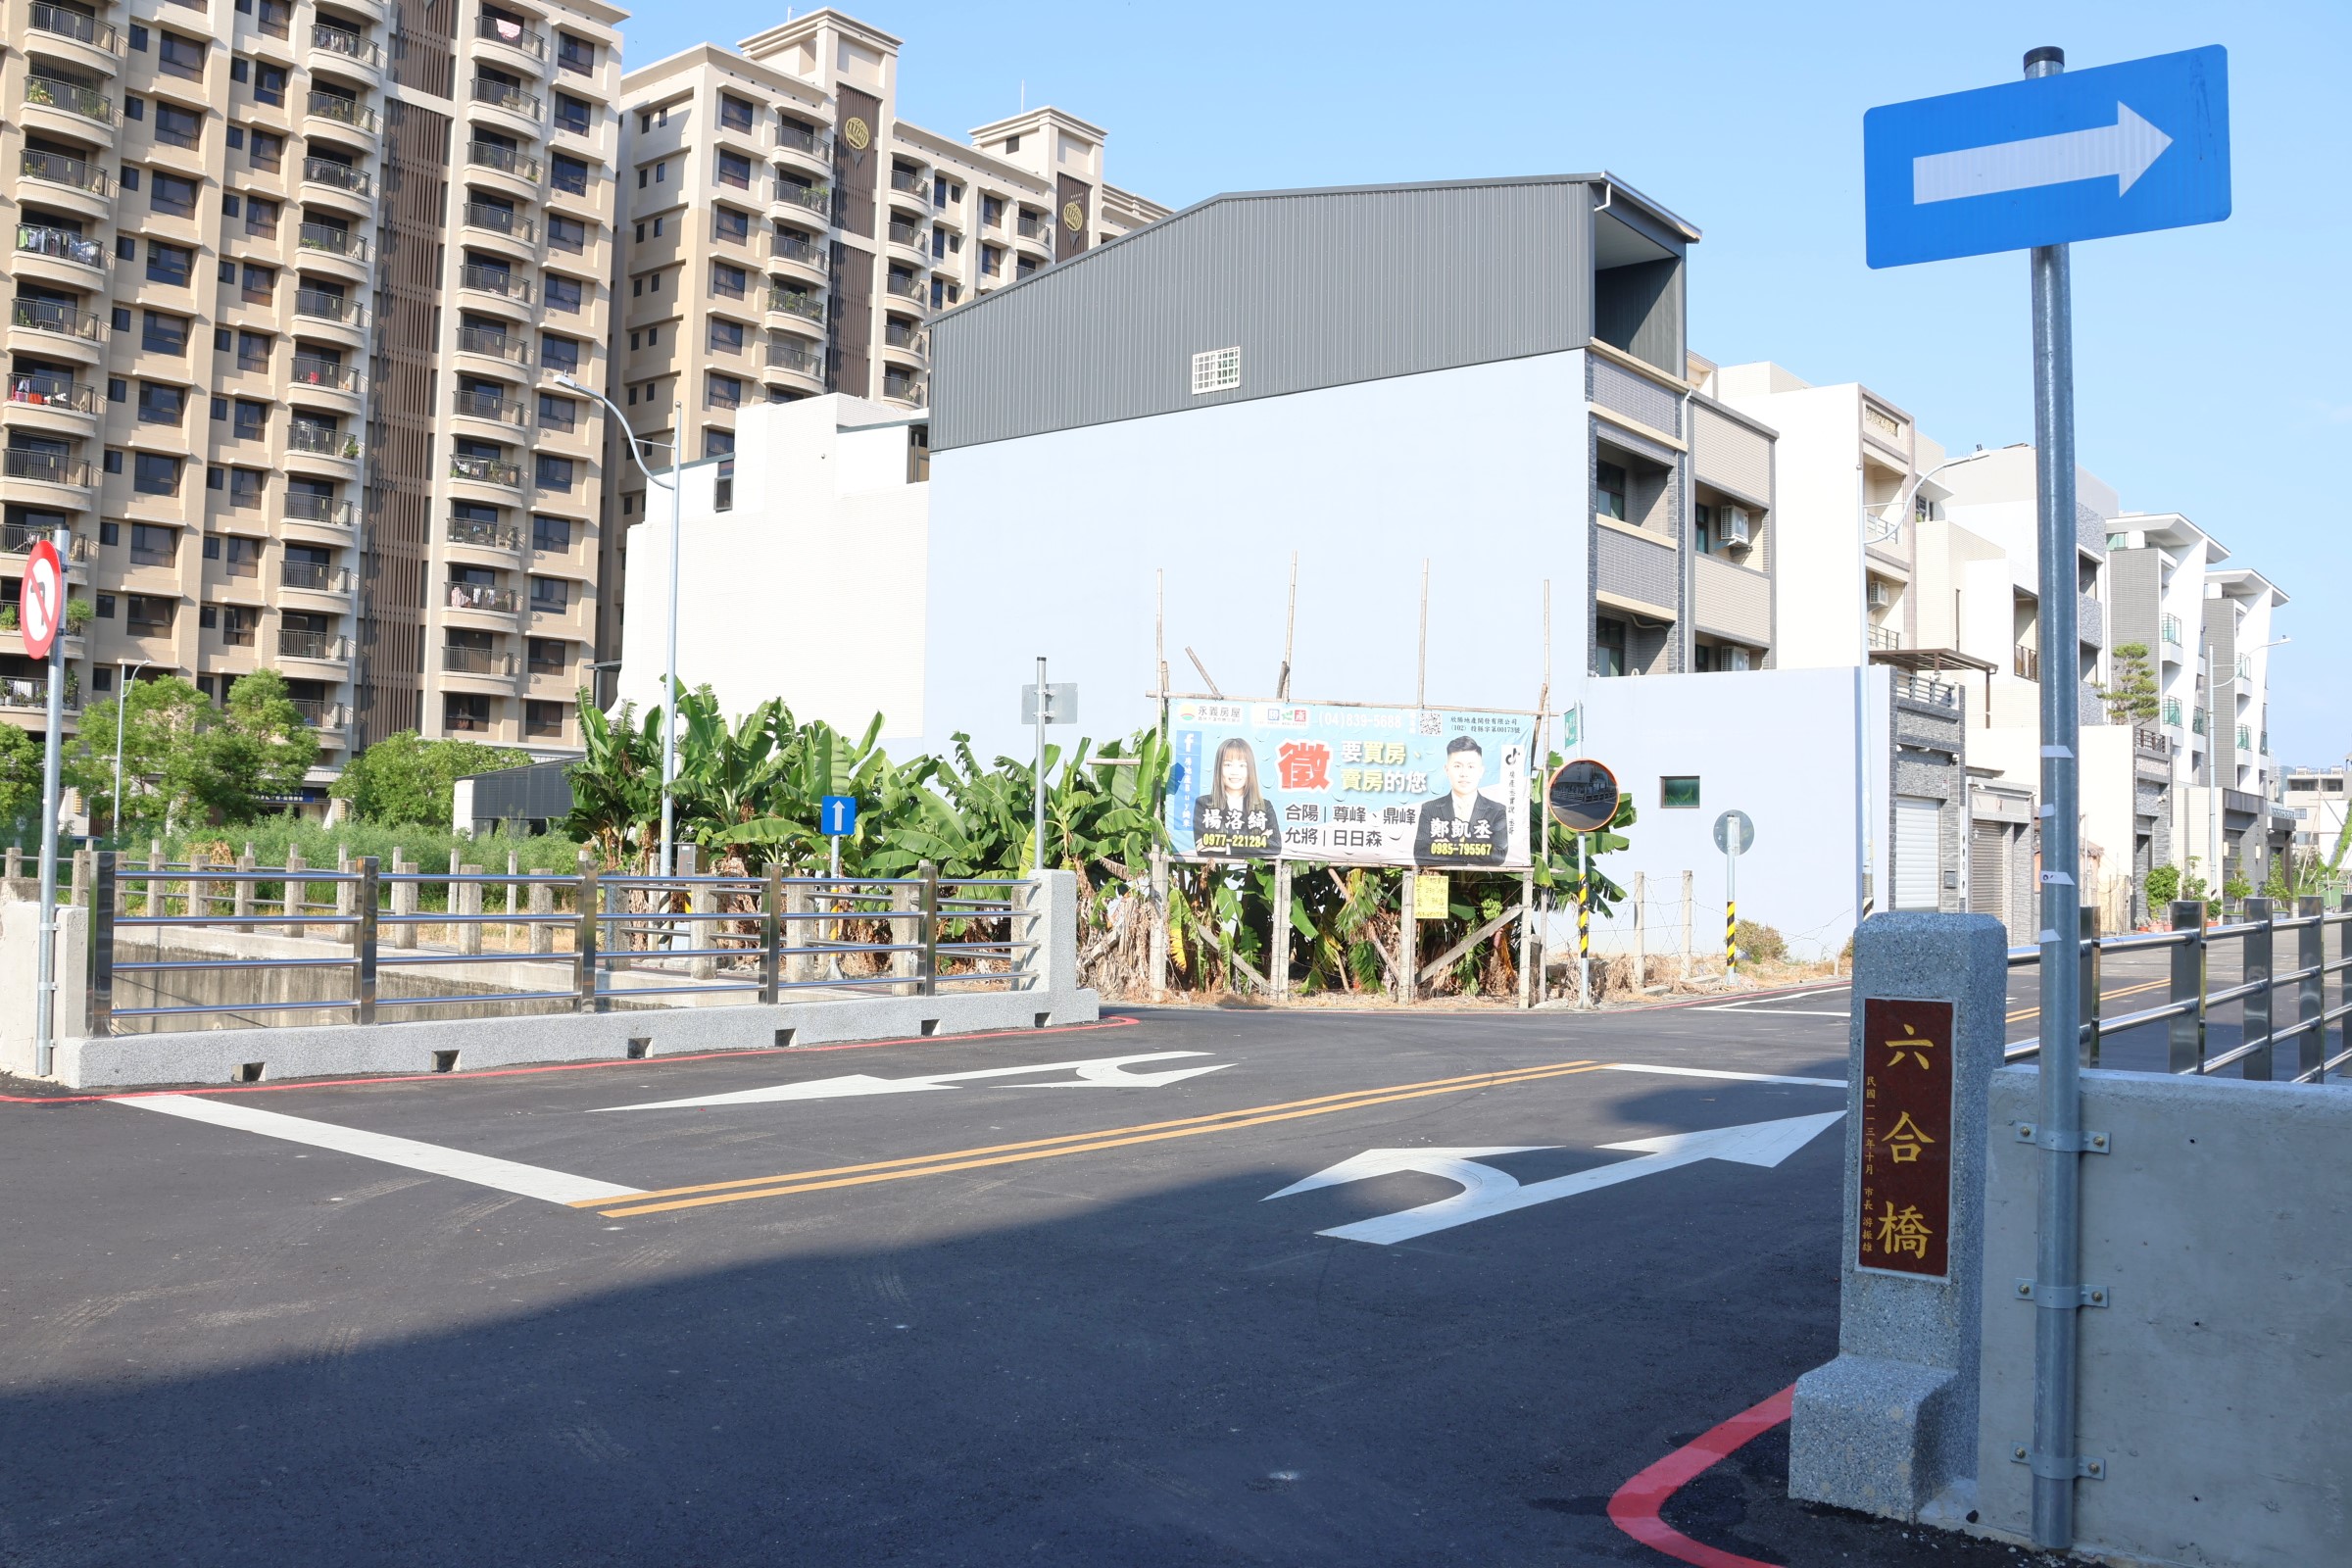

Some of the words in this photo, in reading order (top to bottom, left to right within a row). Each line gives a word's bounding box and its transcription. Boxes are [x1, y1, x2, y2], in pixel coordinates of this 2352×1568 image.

[1198, 706, 1241, 718] 永義房屋
[1318, 711, 1401, 729] (04)839-5688
[1278, 742, 1331, 791] 徵
[1342, 768, 1427, 794] 賣房的您
[1201, 808, 1268, 831] 楊洛綺
[1430, 817, 1493, 839] 鄭凱丞
[1202, 833, 1267, 848] 0977-221284
[1431, 842, 1493, 856] 0985-795567
[1864, 1076, 1877, 1175] 民國一一三年十月
[1876, 1023, 1936, 1259] 六合橋
[1864, 1186, 1874, 1210] 市長
